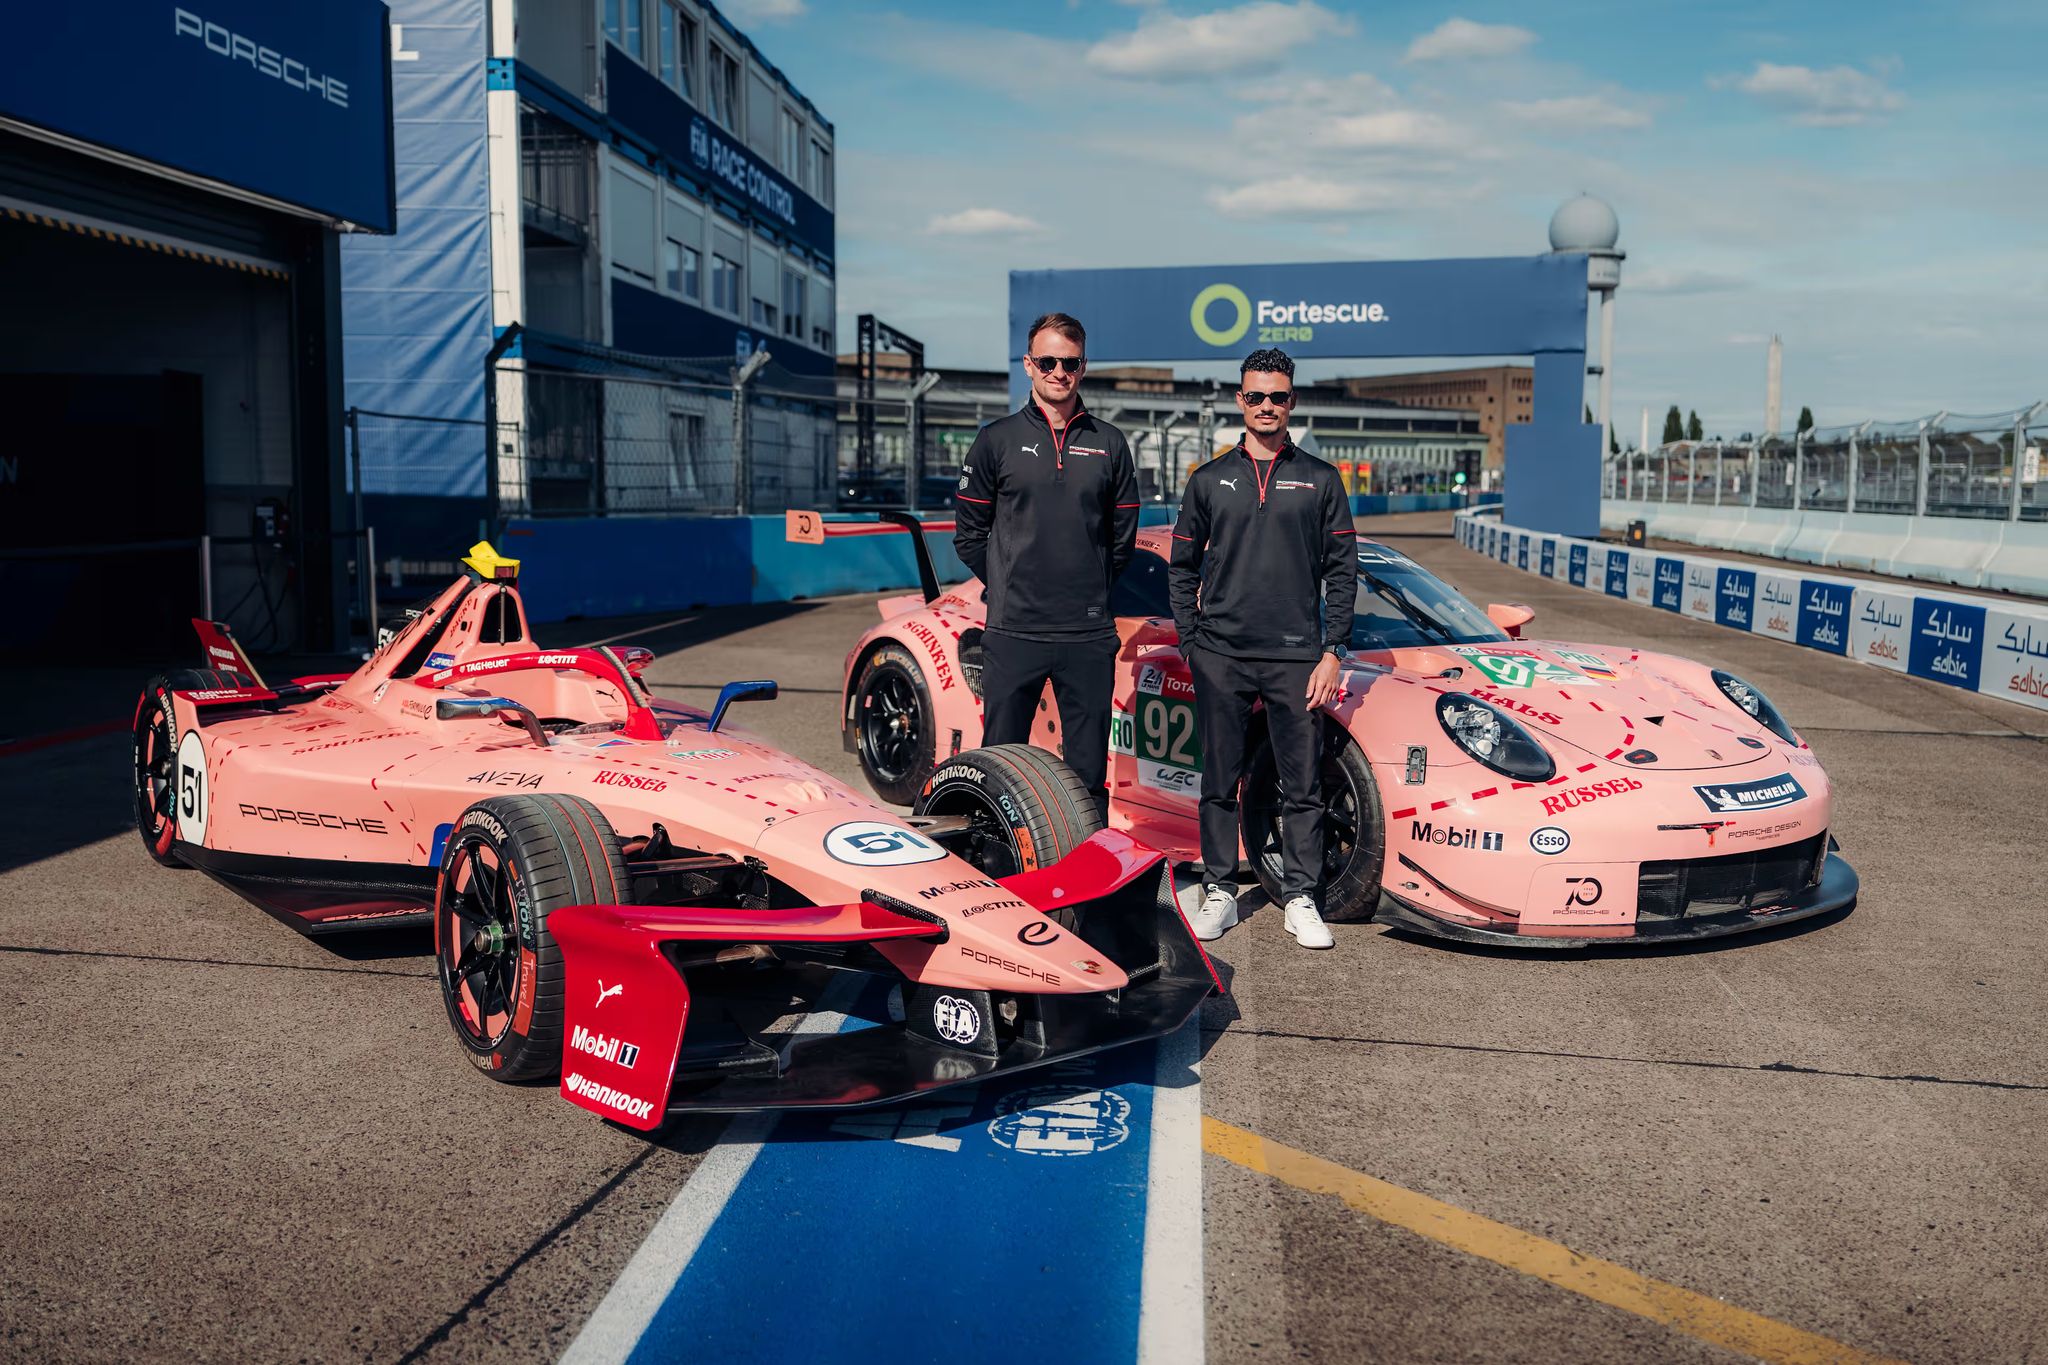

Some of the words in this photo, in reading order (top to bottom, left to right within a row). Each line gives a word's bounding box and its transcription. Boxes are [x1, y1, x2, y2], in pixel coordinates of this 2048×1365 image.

[175, 7, 348, 108] PORSCHE
[711, 137, 746, 191] RACE
[747, 164, 796, 226] CONTROL
[1257, 300, 1384, 324] Fortescue
[1813, 620, 1840, 646] sabic
[1868, 634, 1898, 660] sabic
[537, 655, 578, 664] LOCTITE
[903, 621, 955, 691] SCHINKEN
[1931, 647, 1968, 679] sabic
[1167, 677, 1195, 694] TOTA
[1477, 656, 1570, 686] 92
[1469, 688, 1564, 726] HALS
[1112, 717, 1133, 749] RO
[1144, 700, 1195, 767] 92
[466, 770, 545, 790] AVEVA
[1156, 768, 1195, 786] WEC
[182, 764, 202, 823] 51
[1540, 777, 1643, 817] RÜSSEL
[1736, 782, 1797, 803] MICHELIN
[239, 803, 388, 835] PORSCHE
[1728, 826, 1773, 839] PORSCHE
[1774, 820, 1802, 832] DESIGN
[843, 830, 930, 854] 51
[1411, 820, 1477, 849] Mobil
[918, 879, 980, 899] Mobil
[1565, 877, 1603, 906] 70
[961, 899, 1026, 917] LOCTITE
[961, 946, 1061, 986] PORSCHE
[571, 1025, 620, 1063] Mobil
